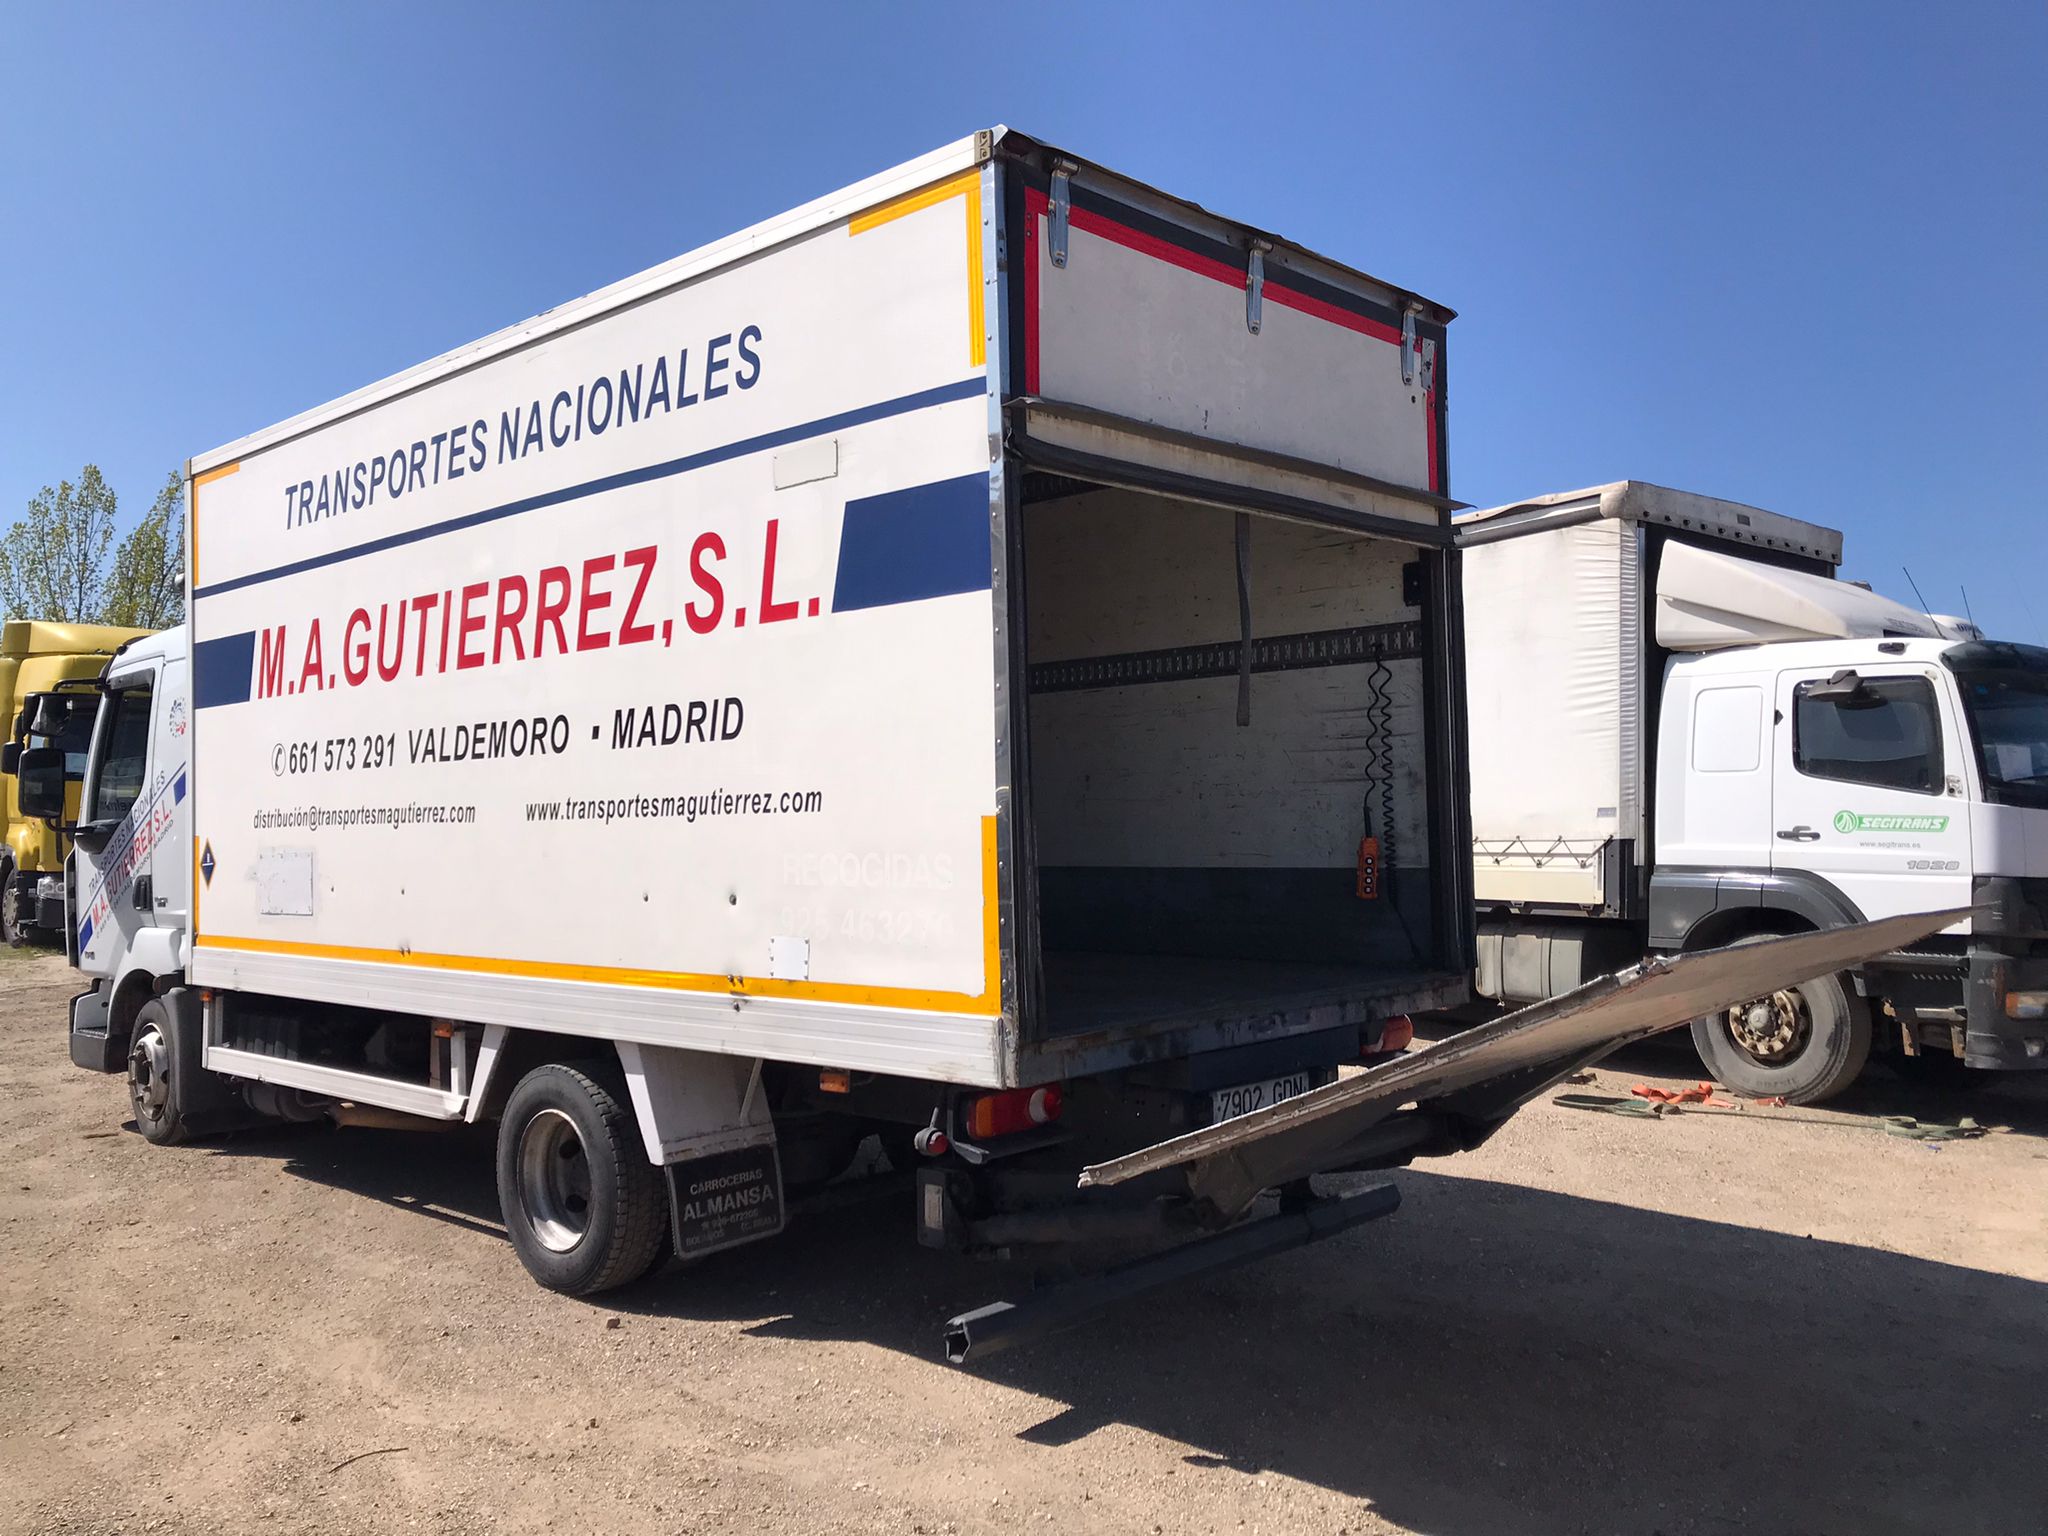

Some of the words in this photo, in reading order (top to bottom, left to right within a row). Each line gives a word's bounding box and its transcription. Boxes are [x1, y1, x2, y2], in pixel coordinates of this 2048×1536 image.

[285, 418, 485, 530] TRANSPORTES
[498, 324, 763, 465] NACIONALES
[290, 741, 317, 774] 661
[325, 738, 355, 771] 573
[363, 733, 395, 768] 291
[409, 715, 569, 763] VALDEMORO
[612, 698, 743, 749] MADRID
[254, 802, 475, 831] distribución@transportesmagutierrez.com
[527, 788, 821, 824] www.transportesmagutierrez.com
[1860, 815, 1943, 830] SEGITRANS
[1859, 840, 1921, 849] www.segitrans.es
[783, 852, 954, 890] RECOGIDAS
[1220, 1086, 1262, 1121] 7902
[689, 1168, 764, 1195] CARROCERIAS
[683, 1184, 774, 1222] ALMANSA
